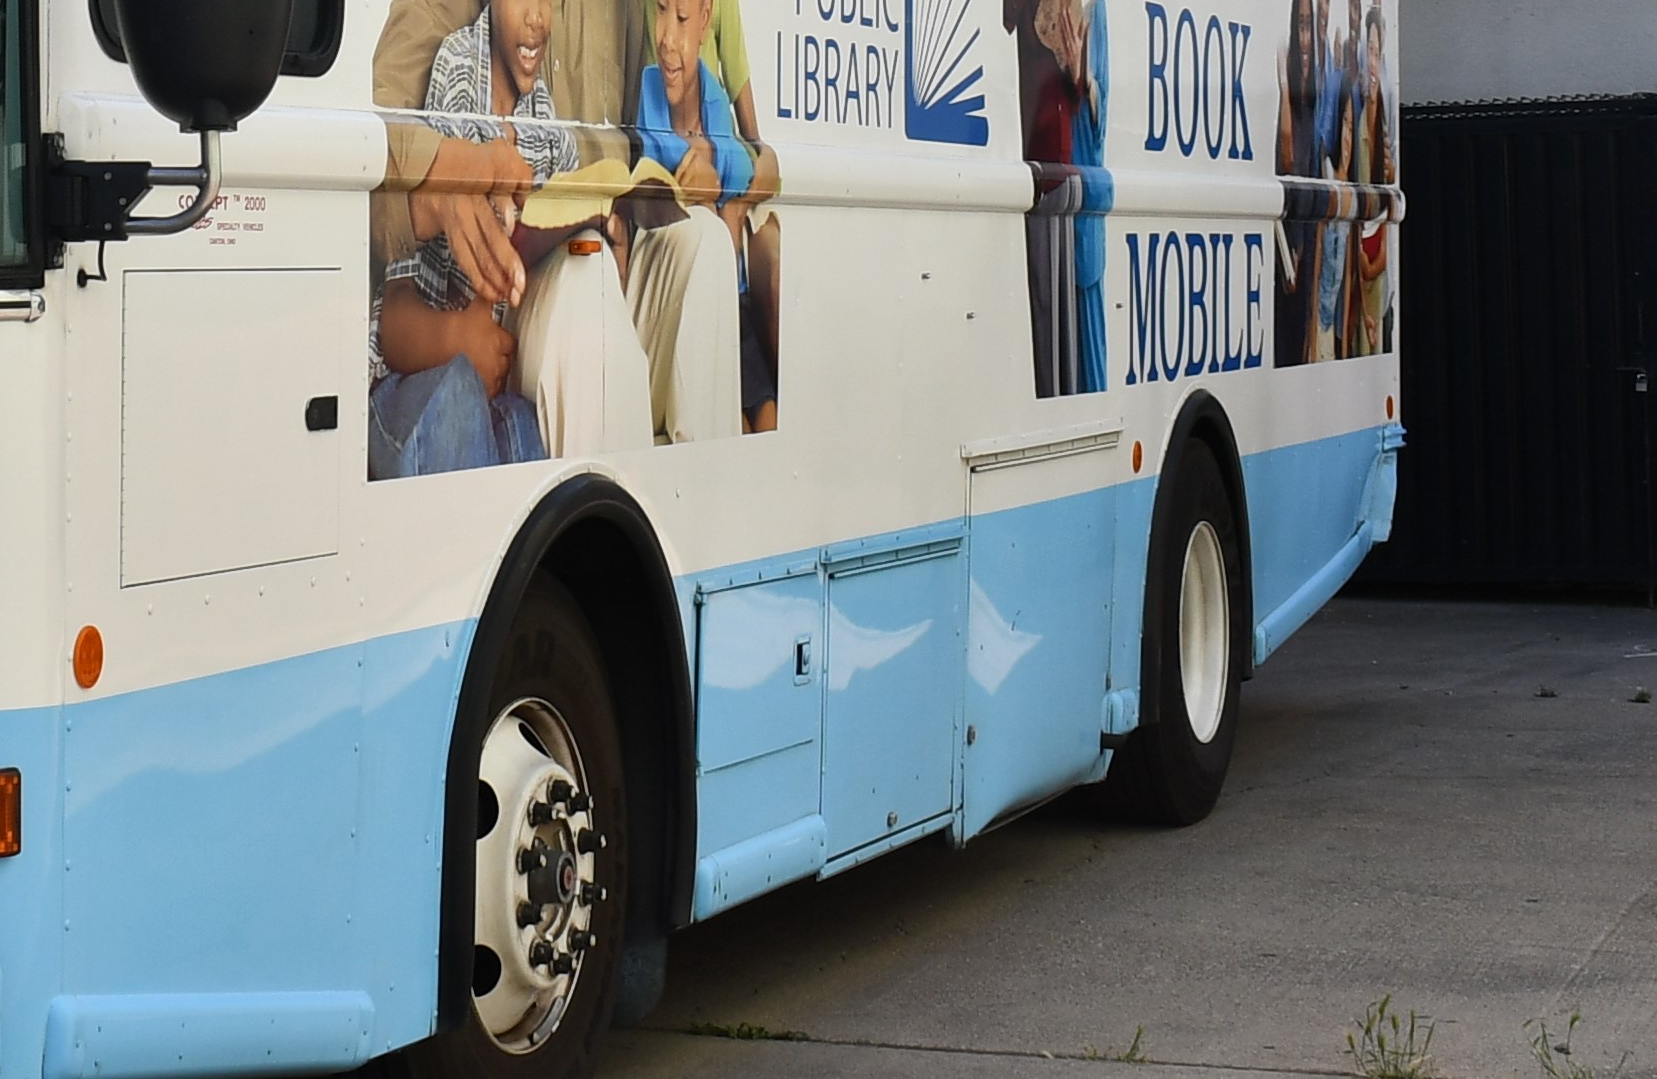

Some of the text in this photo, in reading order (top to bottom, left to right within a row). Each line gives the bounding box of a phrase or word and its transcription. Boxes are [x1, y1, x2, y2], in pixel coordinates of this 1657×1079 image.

[776, 30, 899, 129] LIBRARY
[1144, 1, 1253, 161] BOOK
[244, 196, 266, 211] 2000
[1125, 231, 1265, 386] MOBILE
